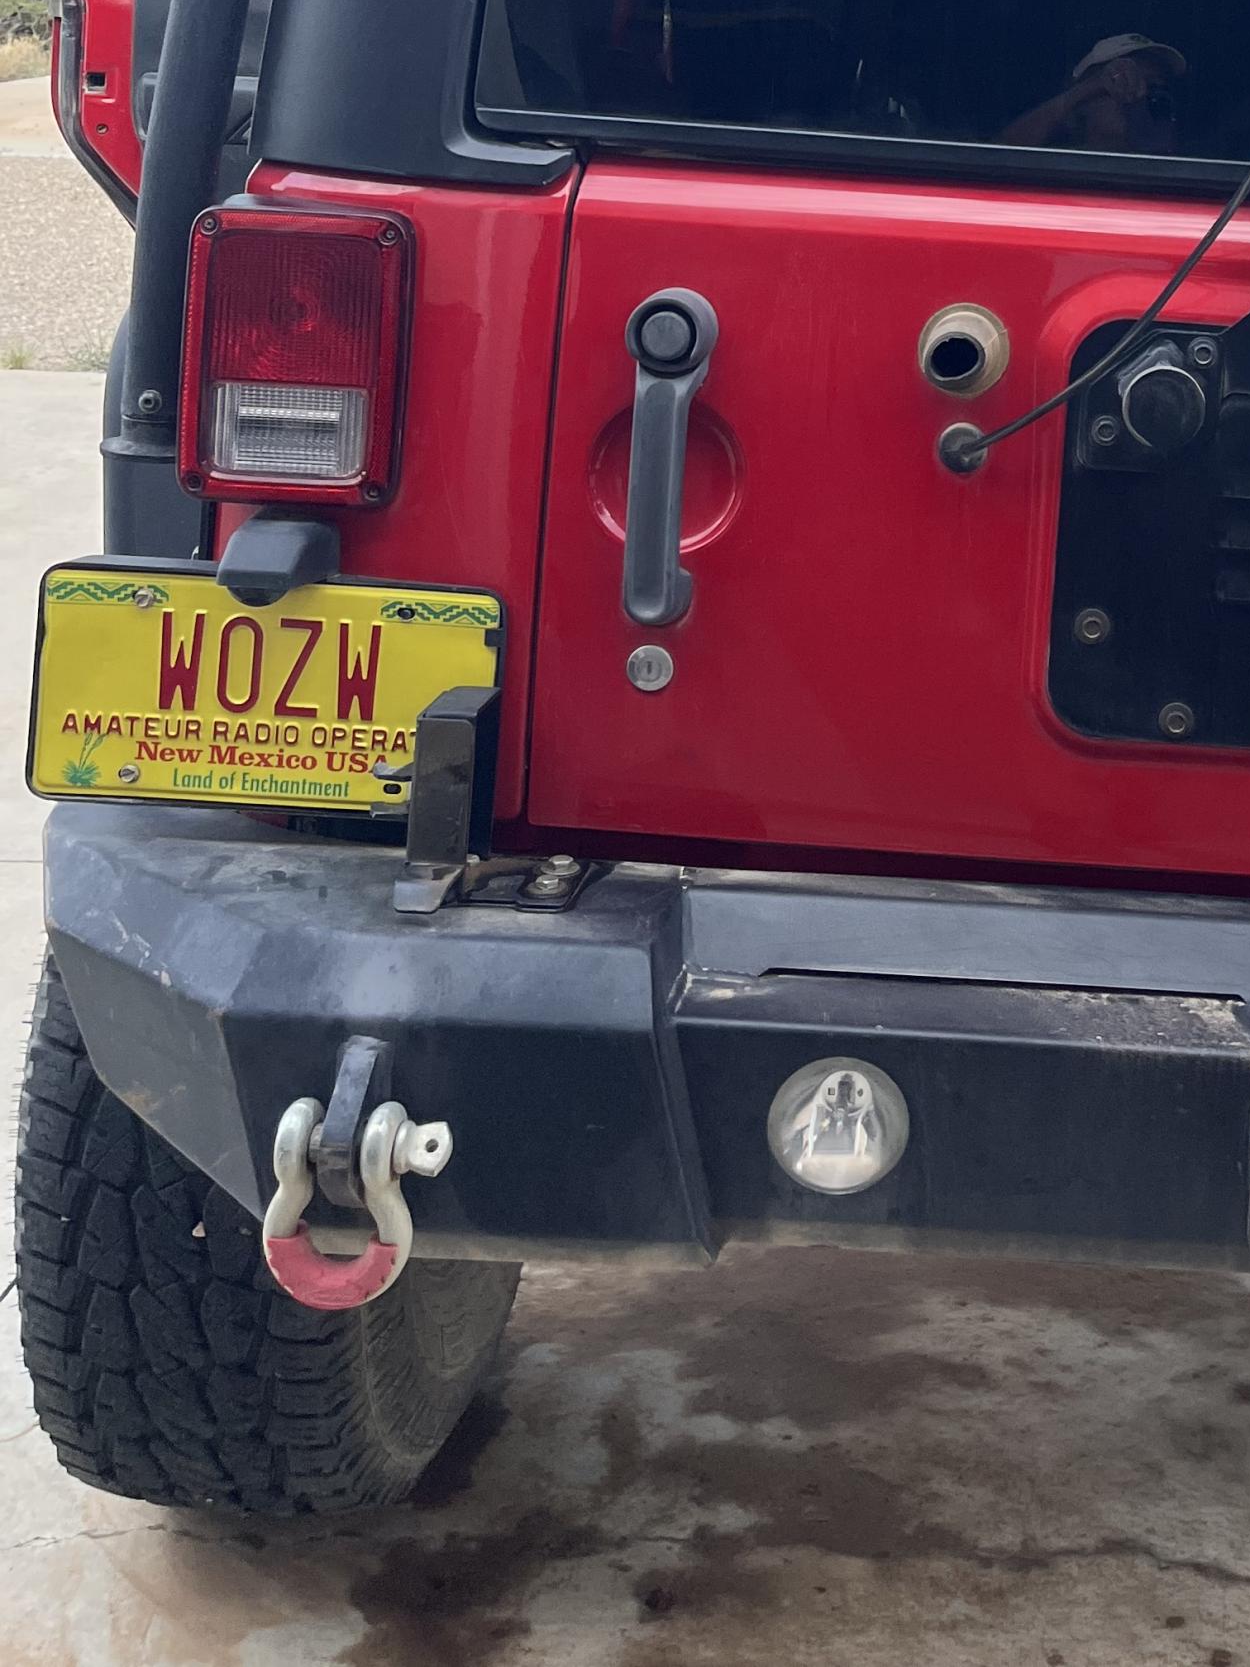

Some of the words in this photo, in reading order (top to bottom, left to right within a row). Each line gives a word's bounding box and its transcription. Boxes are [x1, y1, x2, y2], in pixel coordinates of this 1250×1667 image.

[61, 711, 202, 742] AMATEUR
[212, 719, 300, 746] RADIO
[134, 740, 203, 764] New
[207, 743, 318, 771] Mexico
[173, 767, 213, 790] Land
[218, 771, 237, 790] of
[241, 772, 349, 797] Enchantment
